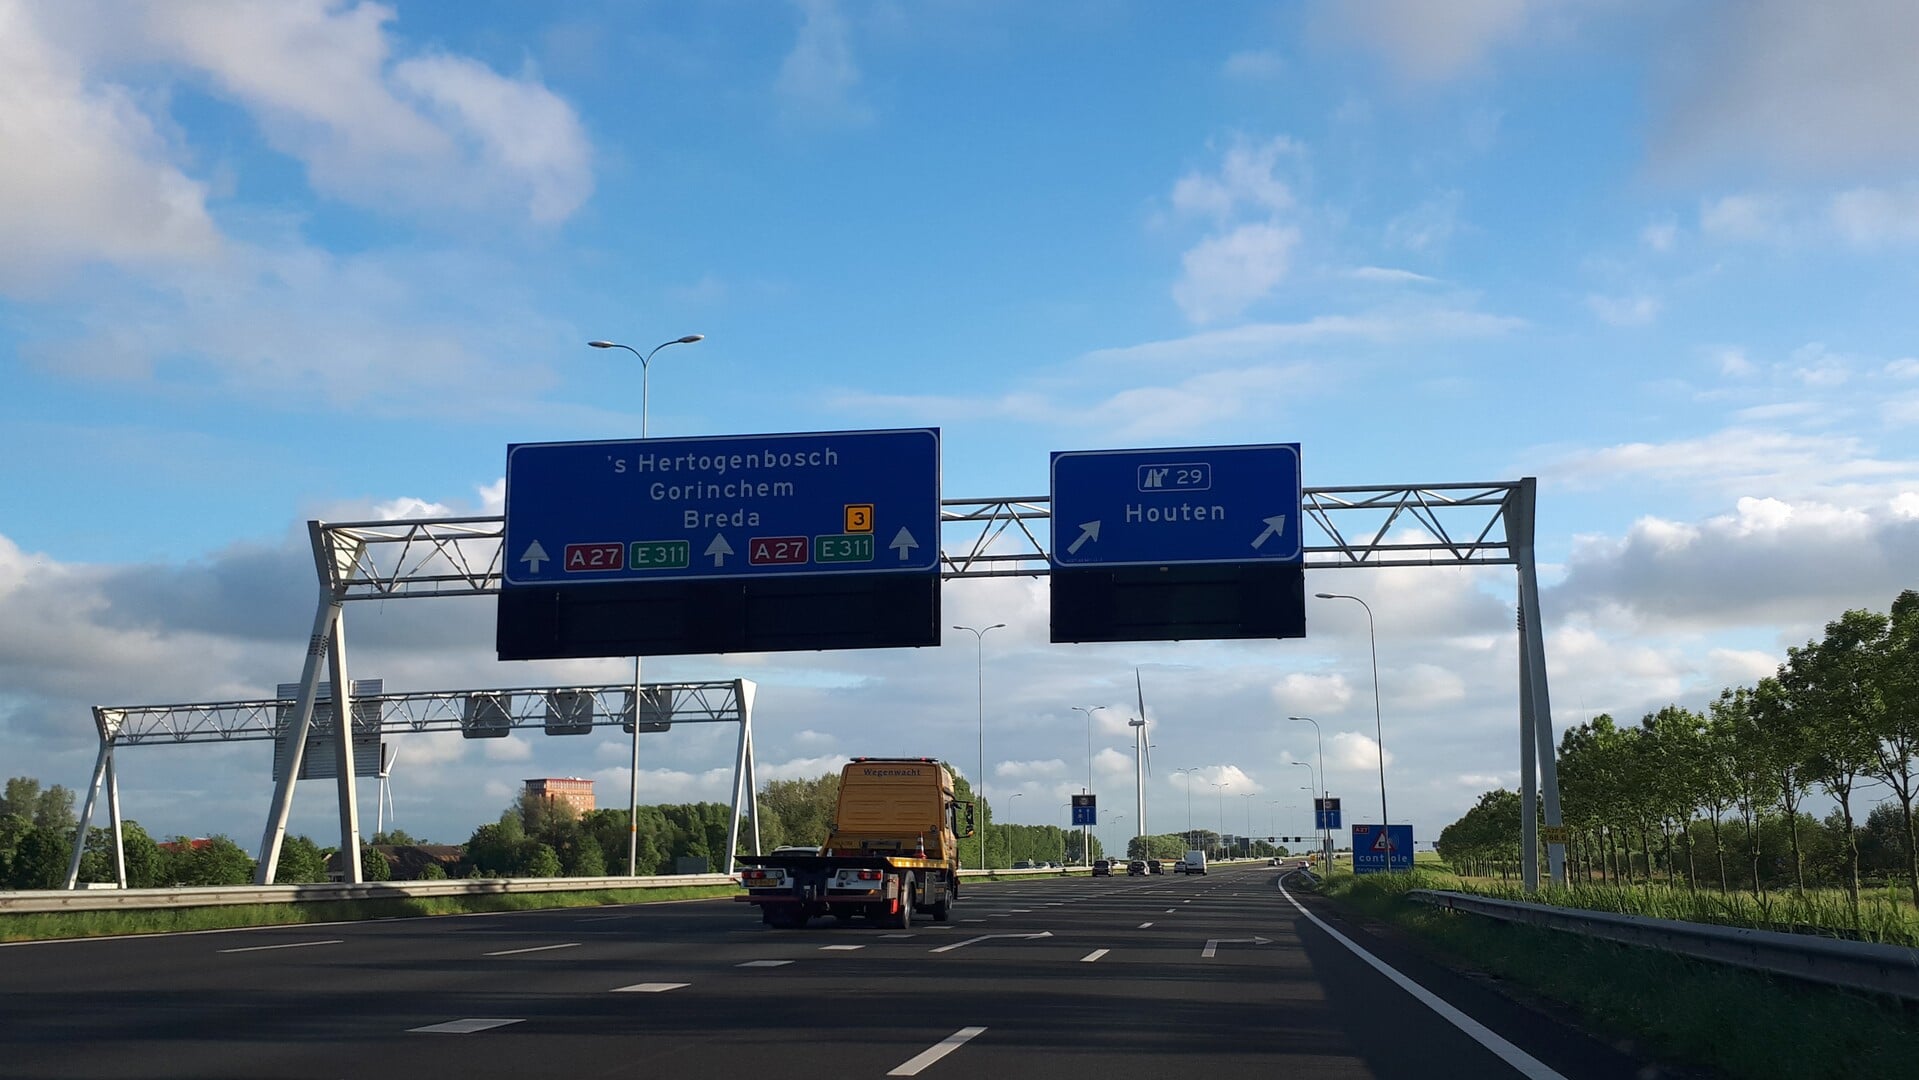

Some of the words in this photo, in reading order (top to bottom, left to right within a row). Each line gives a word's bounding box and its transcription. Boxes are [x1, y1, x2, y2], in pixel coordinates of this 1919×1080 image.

[607, 455, 626, 473] 's
[639, 447, 838, 476] Hertogenbosch
[1177, 469, 1203, 484] 29
[650, 480, 794, 500] Gorinchem
[684, 508, 760, 529] Breda
[853, 511, 865, 526] 3
[1126, 503, 1225, 522] Houten
[863, 768, 921, 777] Wegenwacht
[1359, 854, 1408, 862] contole
